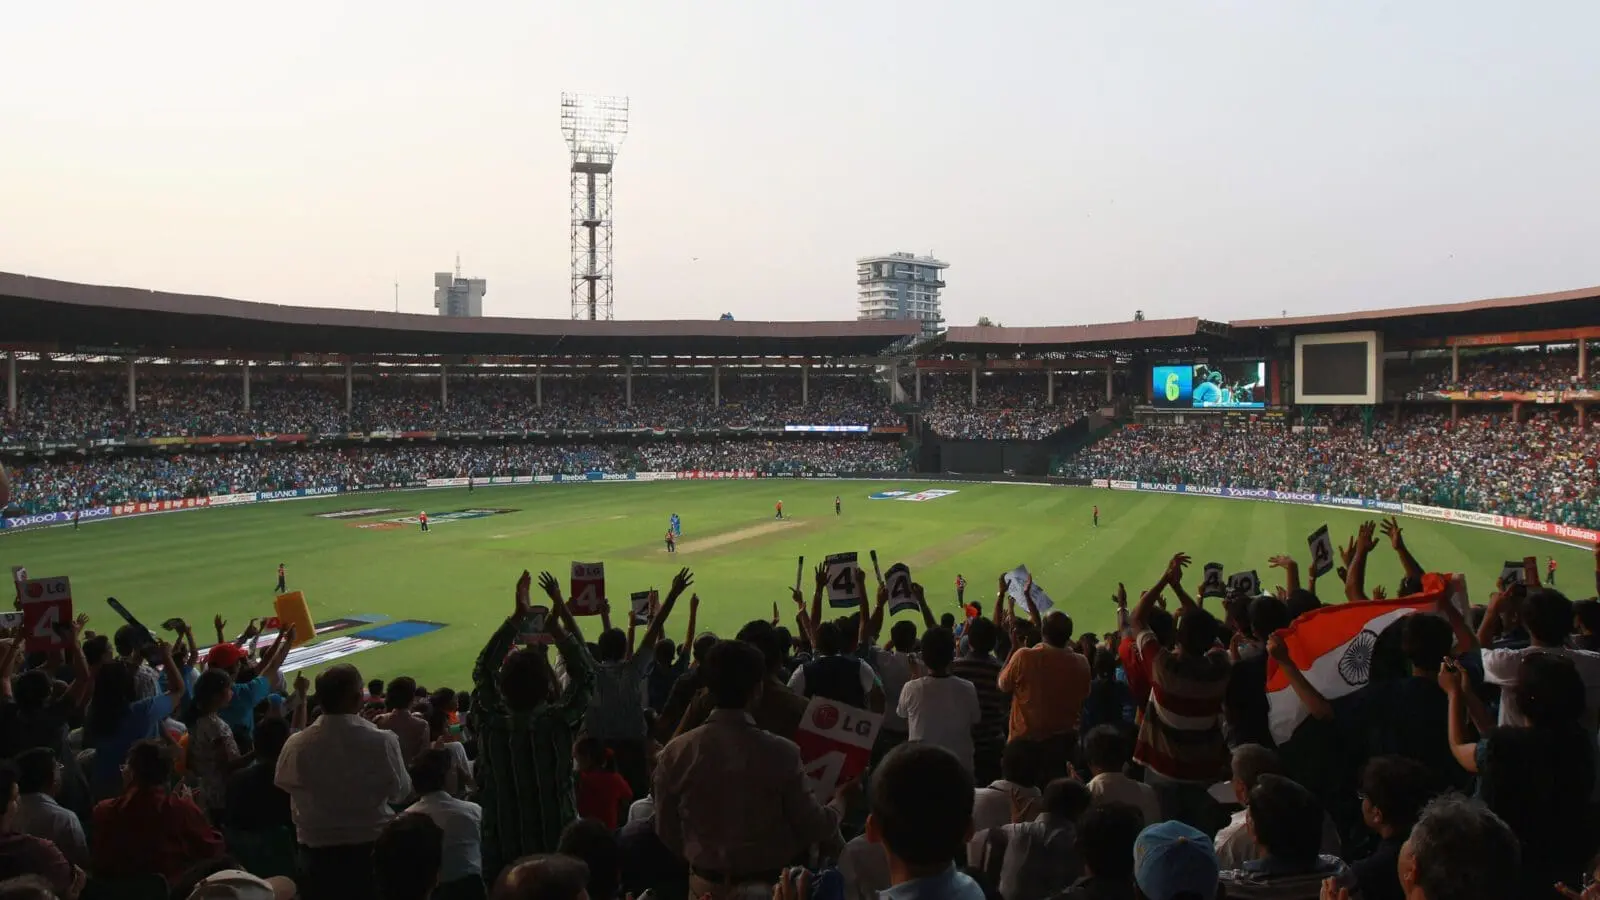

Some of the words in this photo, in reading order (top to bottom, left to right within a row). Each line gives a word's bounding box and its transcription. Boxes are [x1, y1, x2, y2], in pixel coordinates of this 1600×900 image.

[1166, 372, 1179, 401] 6
[562, 472, 587, 481] Reebok
[602, 472, 628, 480] Reebok
[1228, 487, 1269, 497] YAHOO!
[1274, 491, 1316, 501] YAHOO!
[1332, 497, 1363, 505] HYUNDAI
[8, 512, 57, 527] YAHOO!
[62, 507, 110, 521] YHOO!
[1506, 516, 1518, 528] Fly
[1518, 519, 1548, 532] Emirates
[1555, 524, 1567, 536] Fly
[1567, 527, 1597, 541] Emirates
[586, 567, 601, 575] LG
[832, 567, 856, 594] 4
[891, 576, 912, 598] 4
[46, 583, 66, 595] LG
[577, 583, 598, 611] 4
[34, 605, 64, 644] 4
[842, 715, 872, 738] LG
